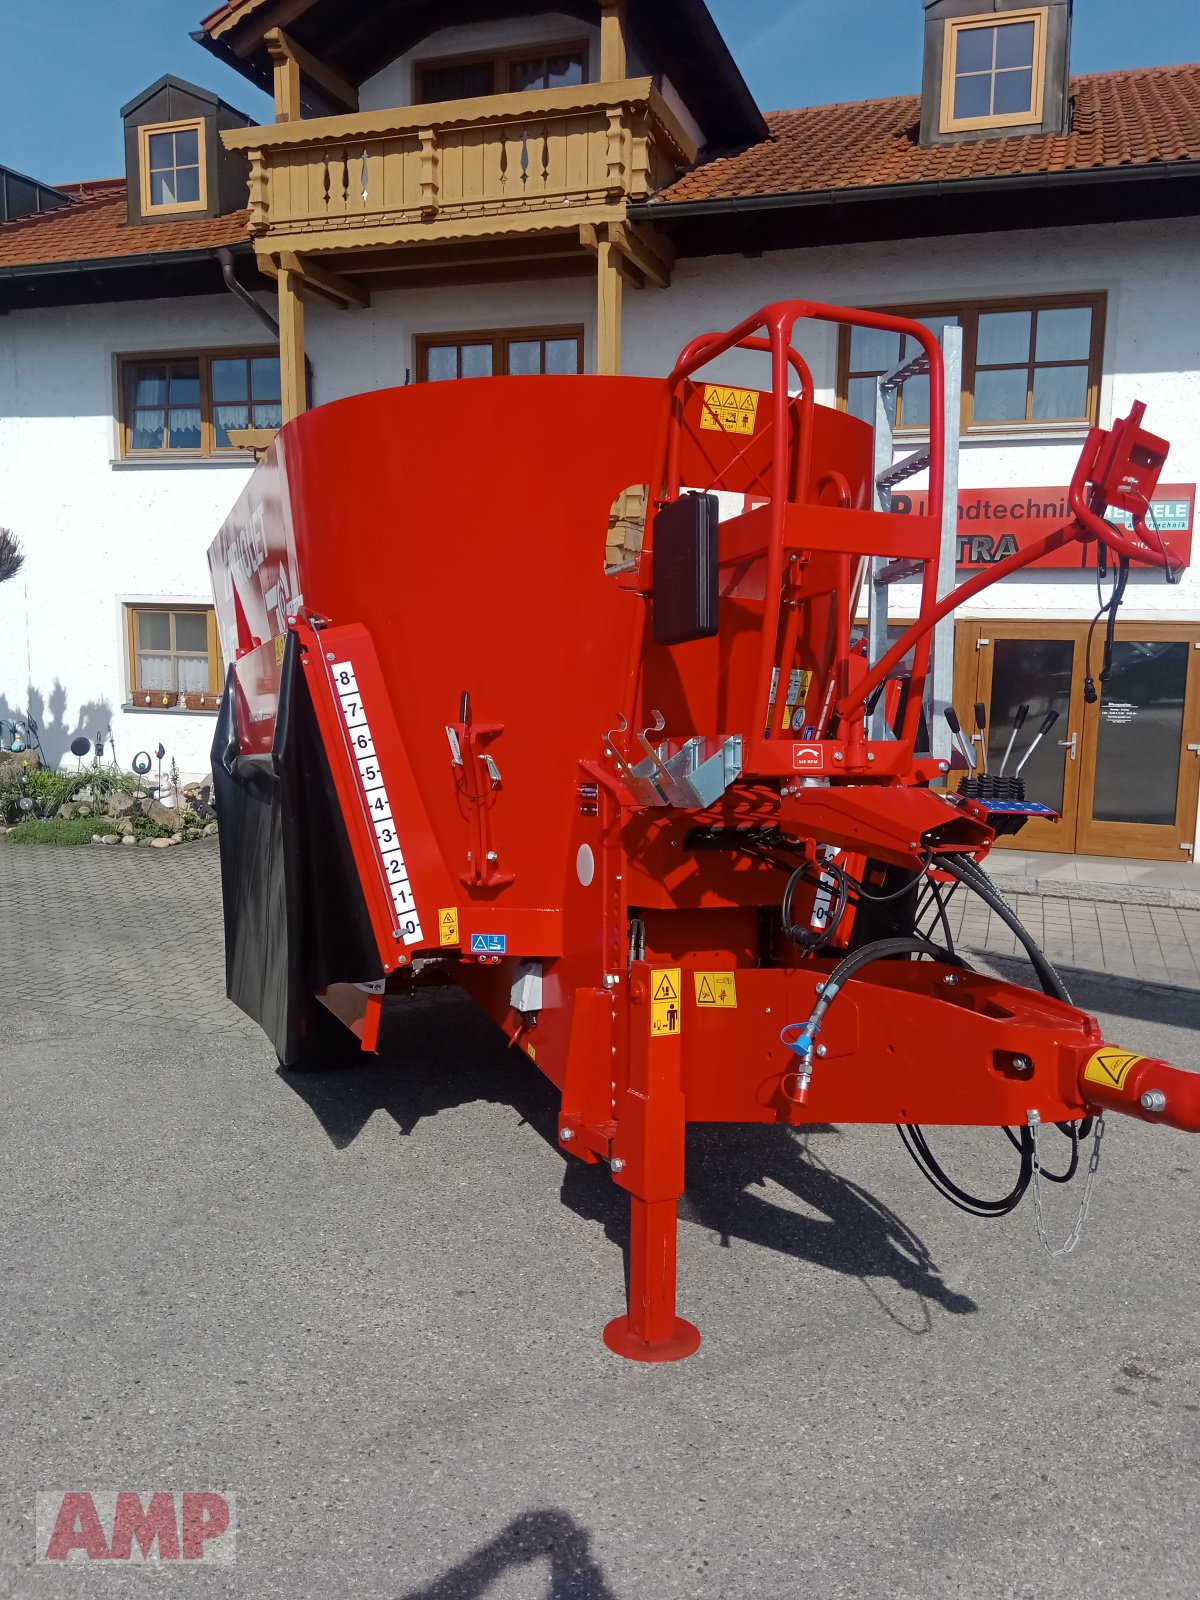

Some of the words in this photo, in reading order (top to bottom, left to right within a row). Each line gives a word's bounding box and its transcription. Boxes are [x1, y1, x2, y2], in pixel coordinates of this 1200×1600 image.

[339, 671, 351, 685] 8
[347, 702, 357, 717] 7
[357, 735, 368, 749] 6
[365, 766, 376, 780] 5
[374, 797, 385, 811] 4
[381, 829, 393, 843] 3
[389, 860, 401, 874] 2
[398, 890, 406, 903] 1
[405, 920, 416, 935] 0
